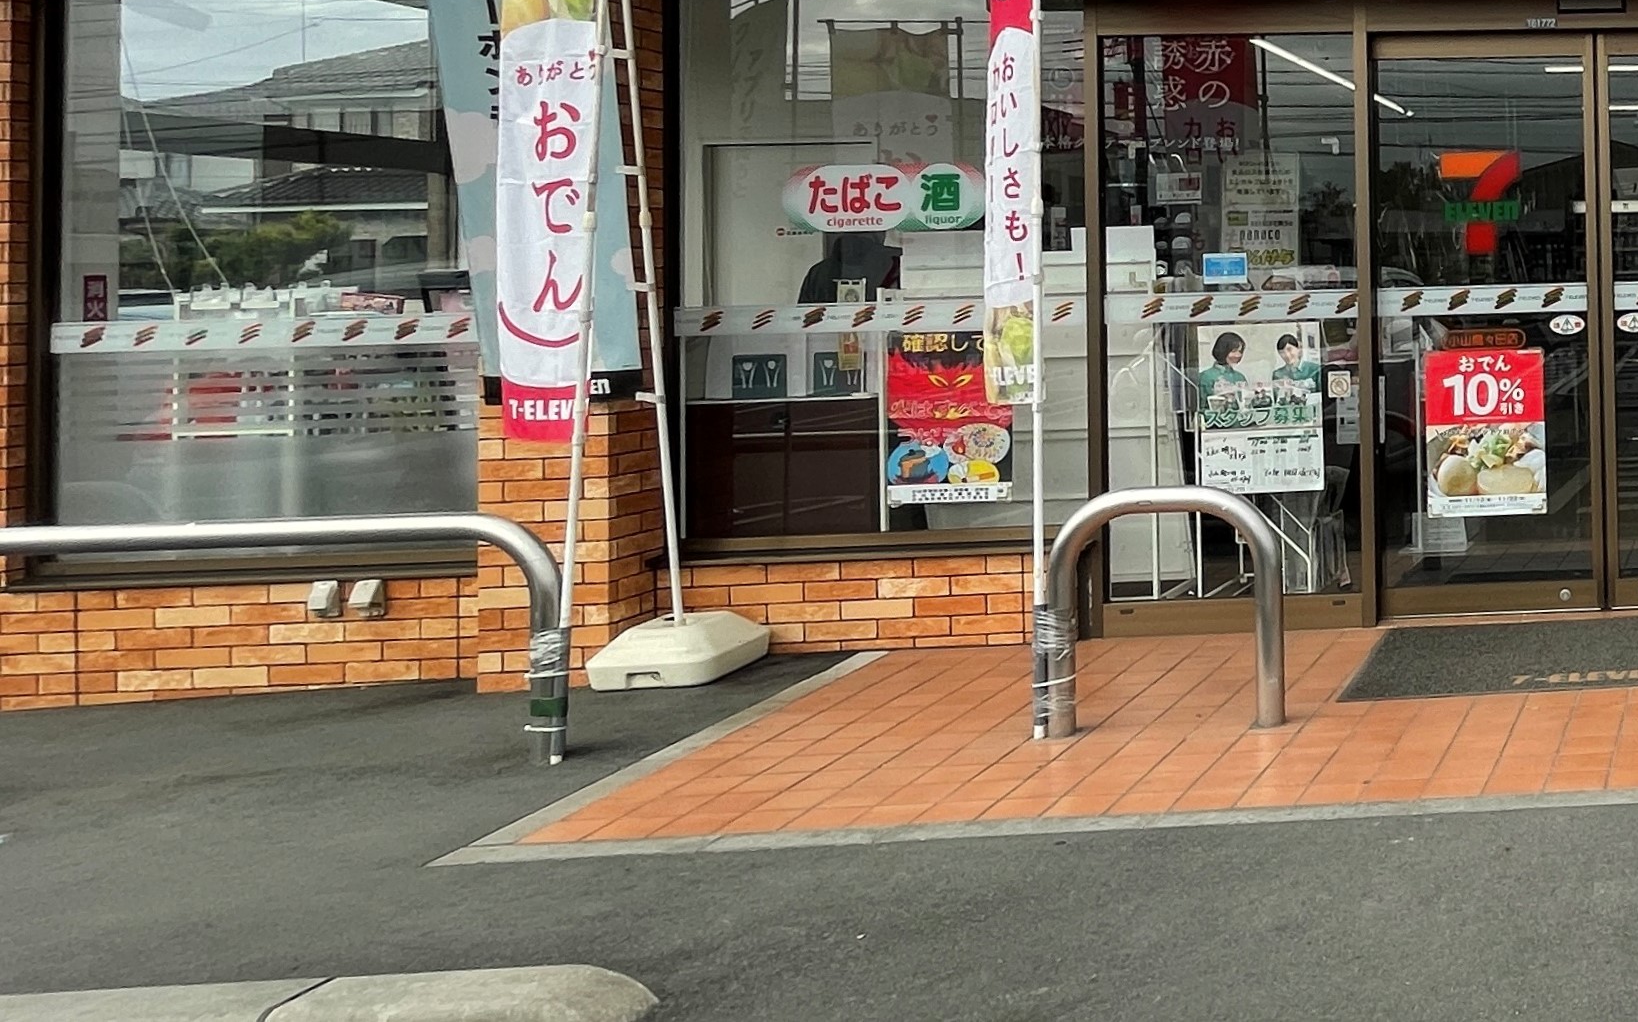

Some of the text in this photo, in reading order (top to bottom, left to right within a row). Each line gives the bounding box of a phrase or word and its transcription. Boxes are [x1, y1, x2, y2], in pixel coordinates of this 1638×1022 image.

[533, 100, 583, 313] おでん
[808, 173, 902, 215] たばこ
[920, 174, 961, 213] 酒
[826, 214, 884, 229] cigarette
[925, 214, 963, 227] liquor
[1458, 355, 1512, 373] おでん
